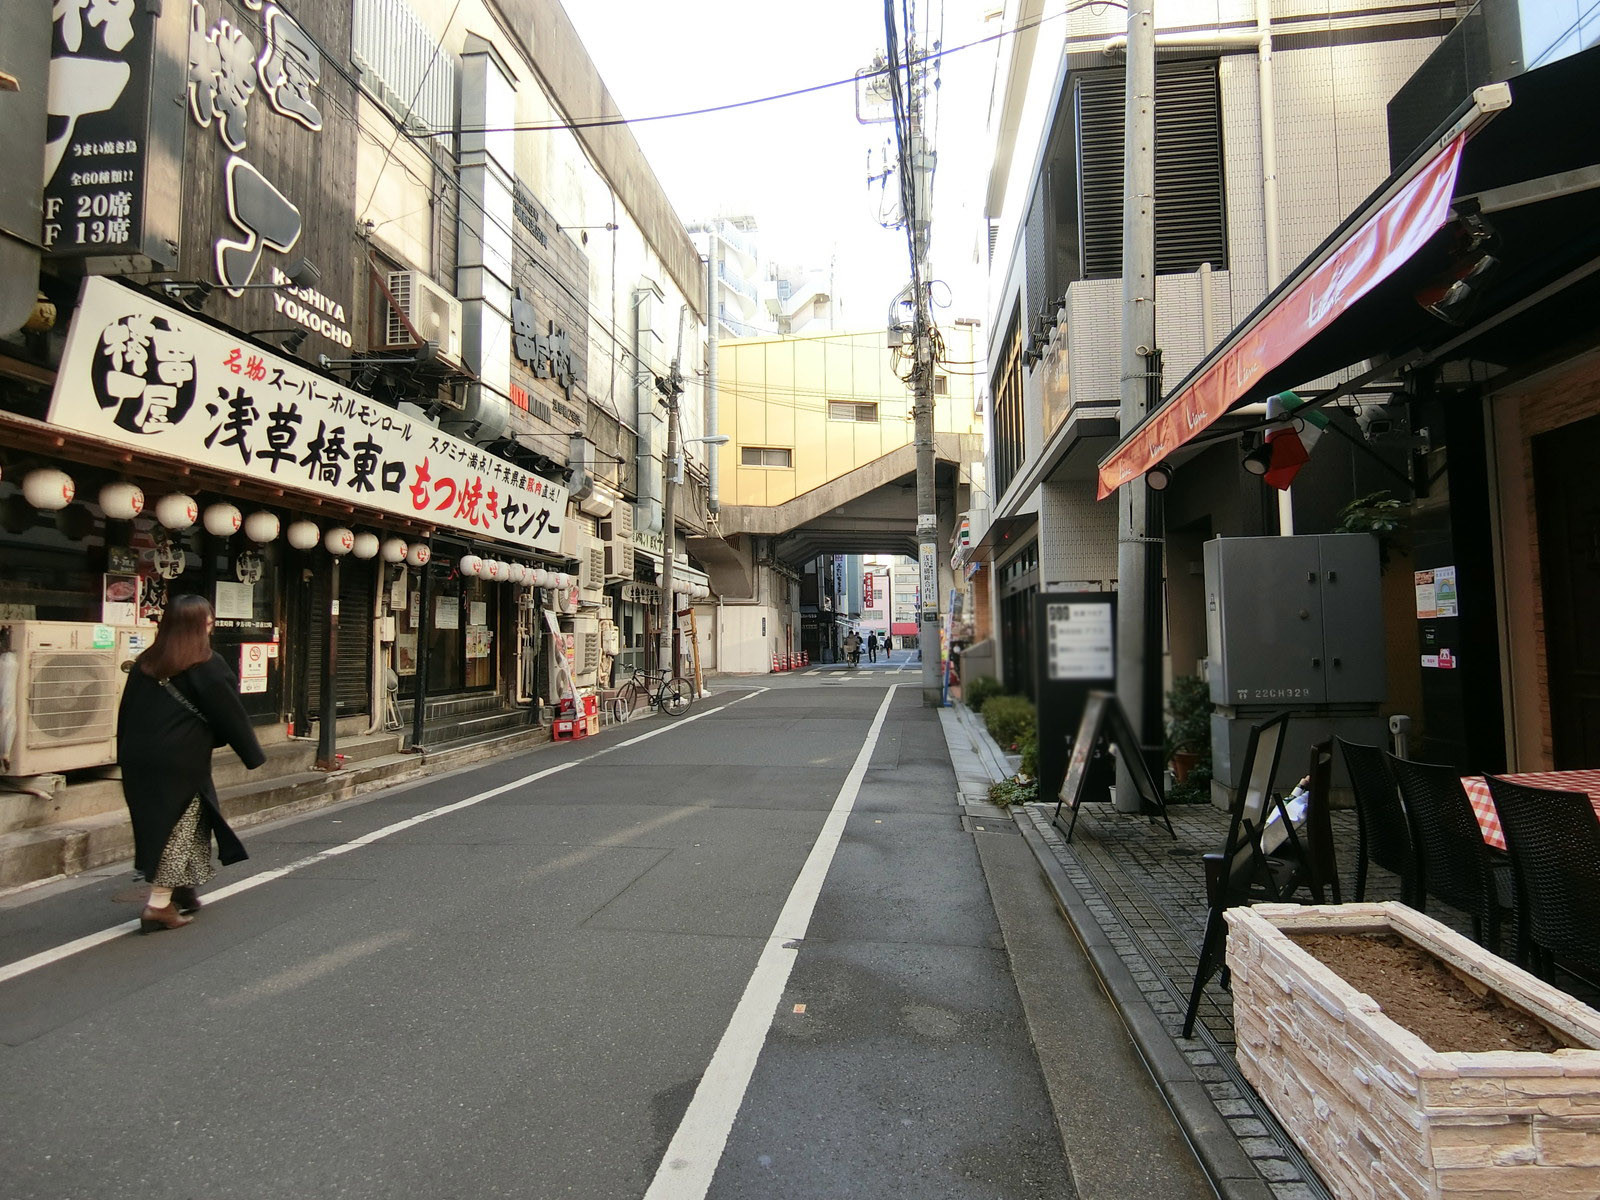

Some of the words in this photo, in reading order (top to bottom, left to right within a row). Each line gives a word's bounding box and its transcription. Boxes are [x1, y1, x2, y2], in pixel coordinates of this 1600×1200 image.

[73, 140, 137, 157] うまい焼き鳥
[77, 191, 133, 218] 20席
[76, 218, 131, 244] 13席
[273, 291, 352, 349] YOKOCHO
